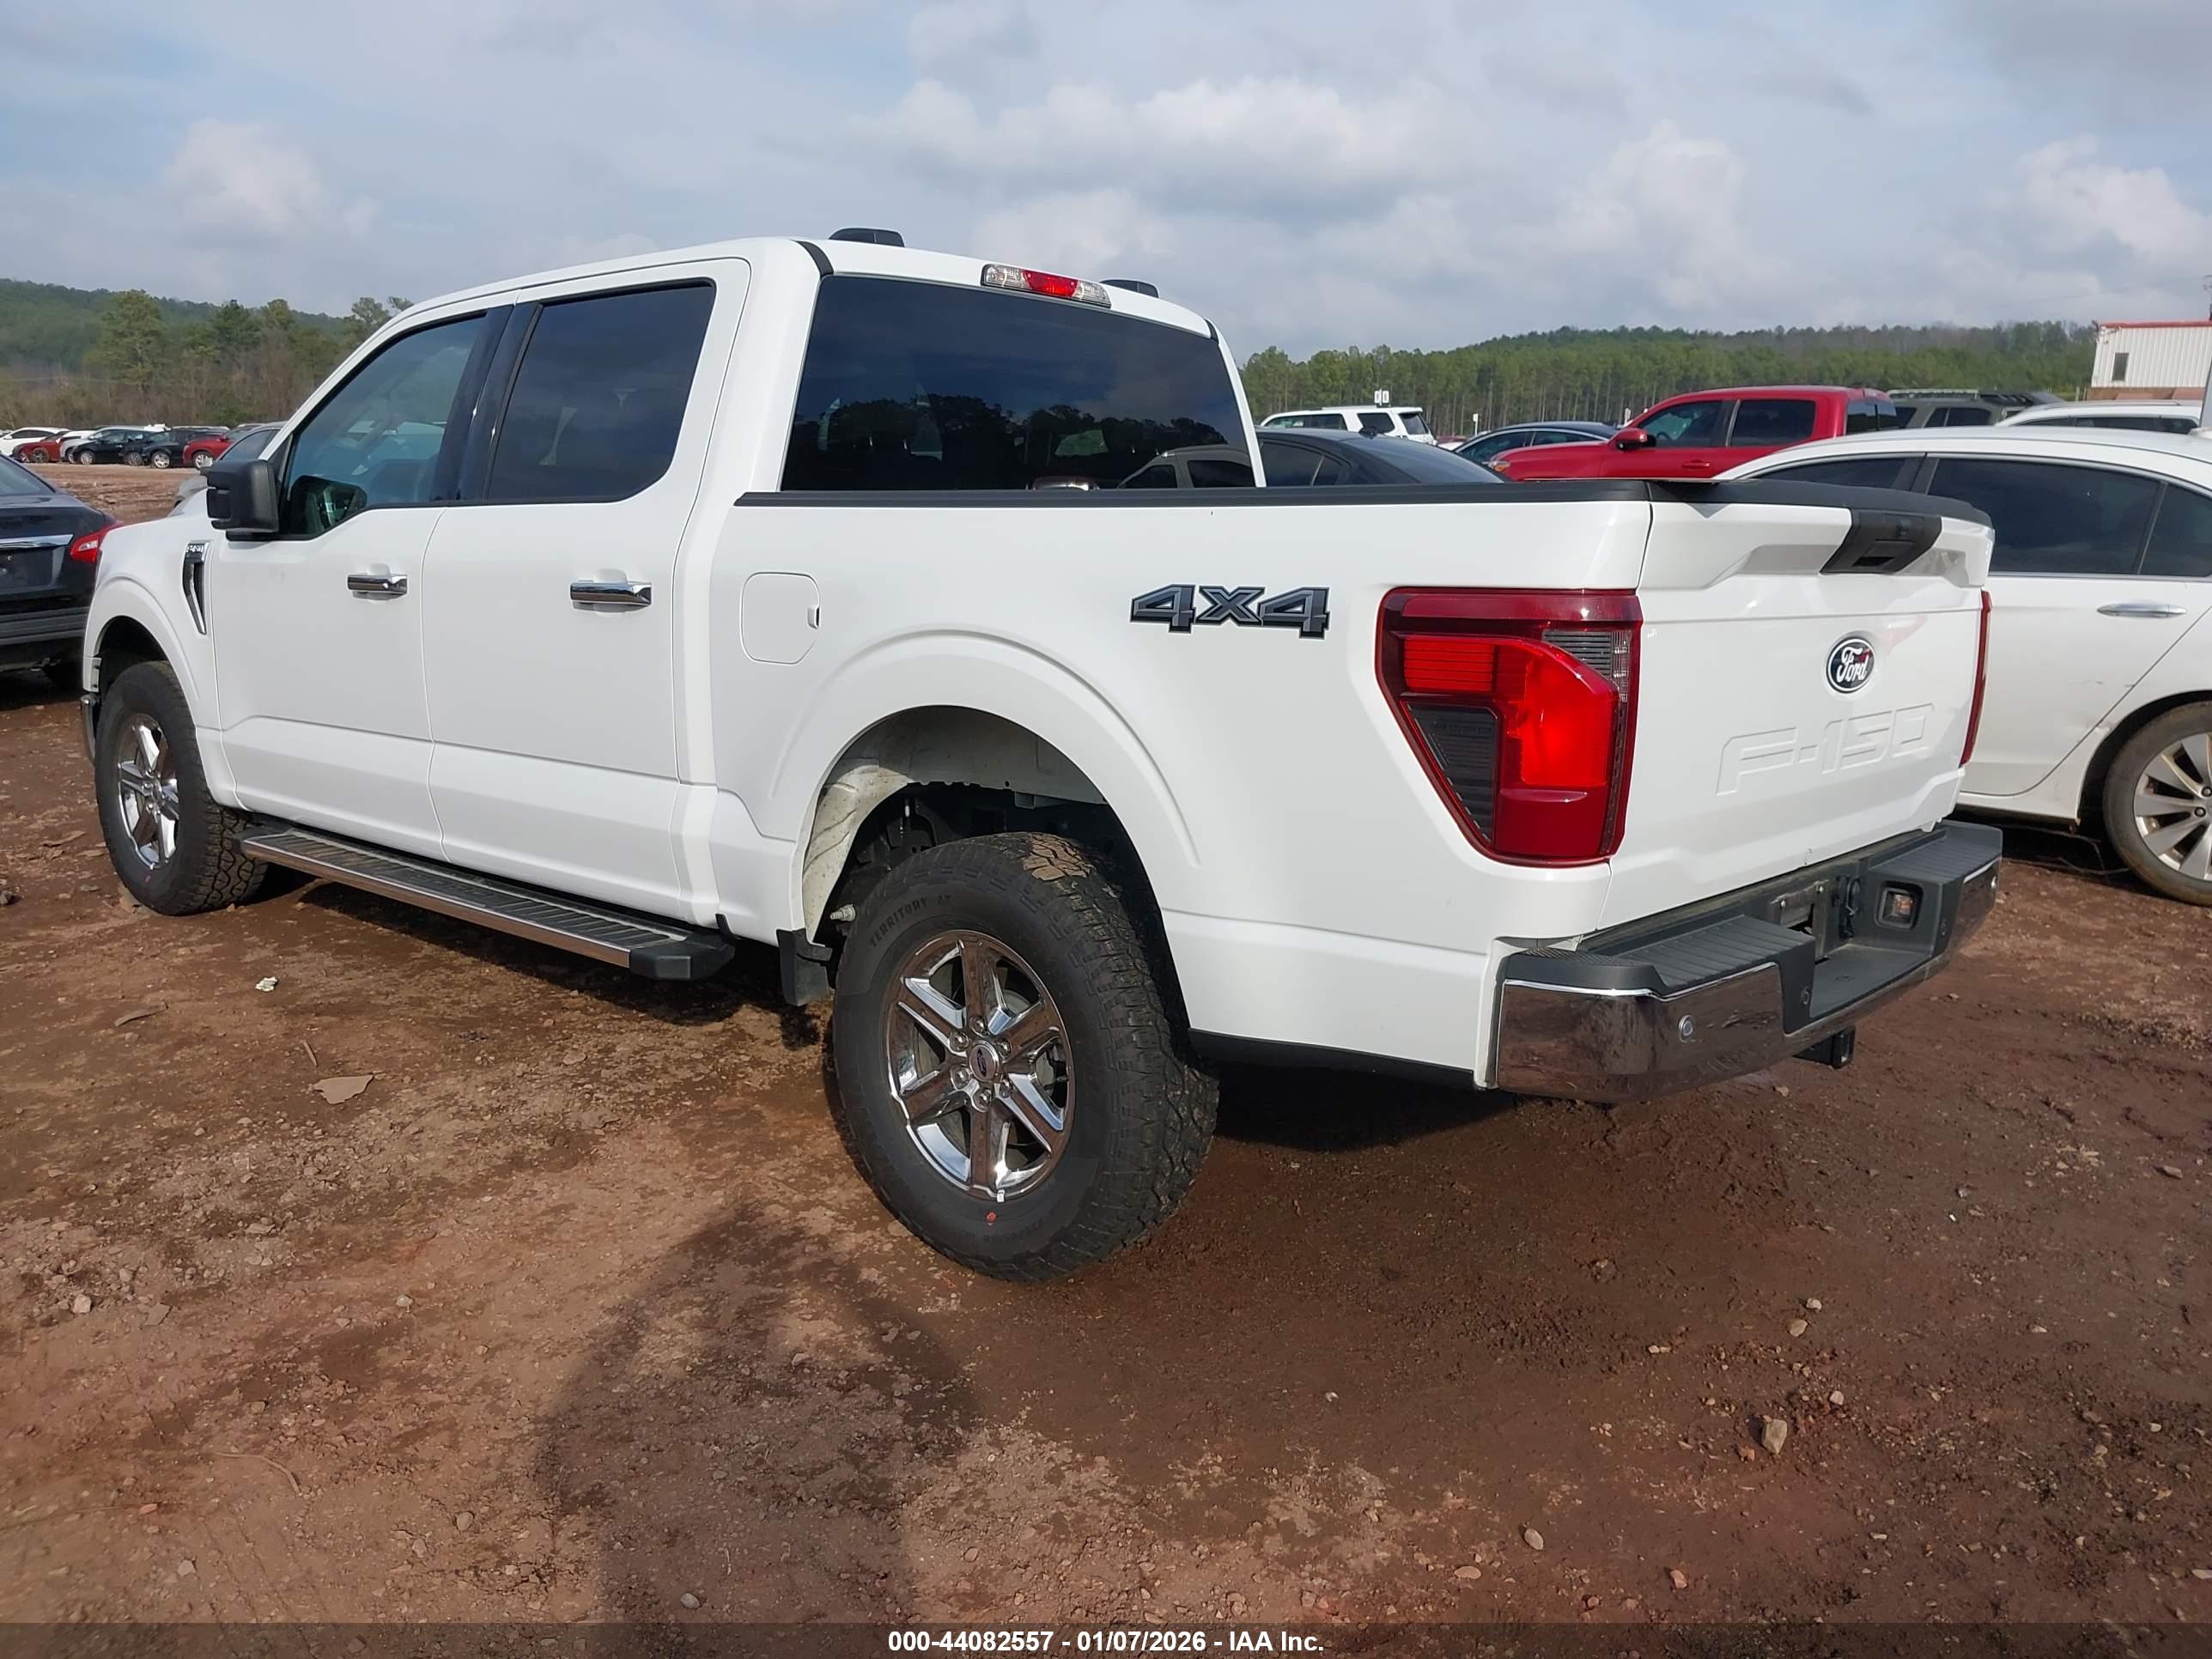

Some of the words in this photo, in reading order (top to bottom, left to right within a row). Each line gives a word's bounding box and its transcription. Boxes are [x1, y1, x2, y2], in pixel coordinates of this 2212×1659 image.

[1837, 647, 1869, 683] Ford
[1717, 702, 1935, 796] F-150
[869, 896, 928, 947] TERRITORY
